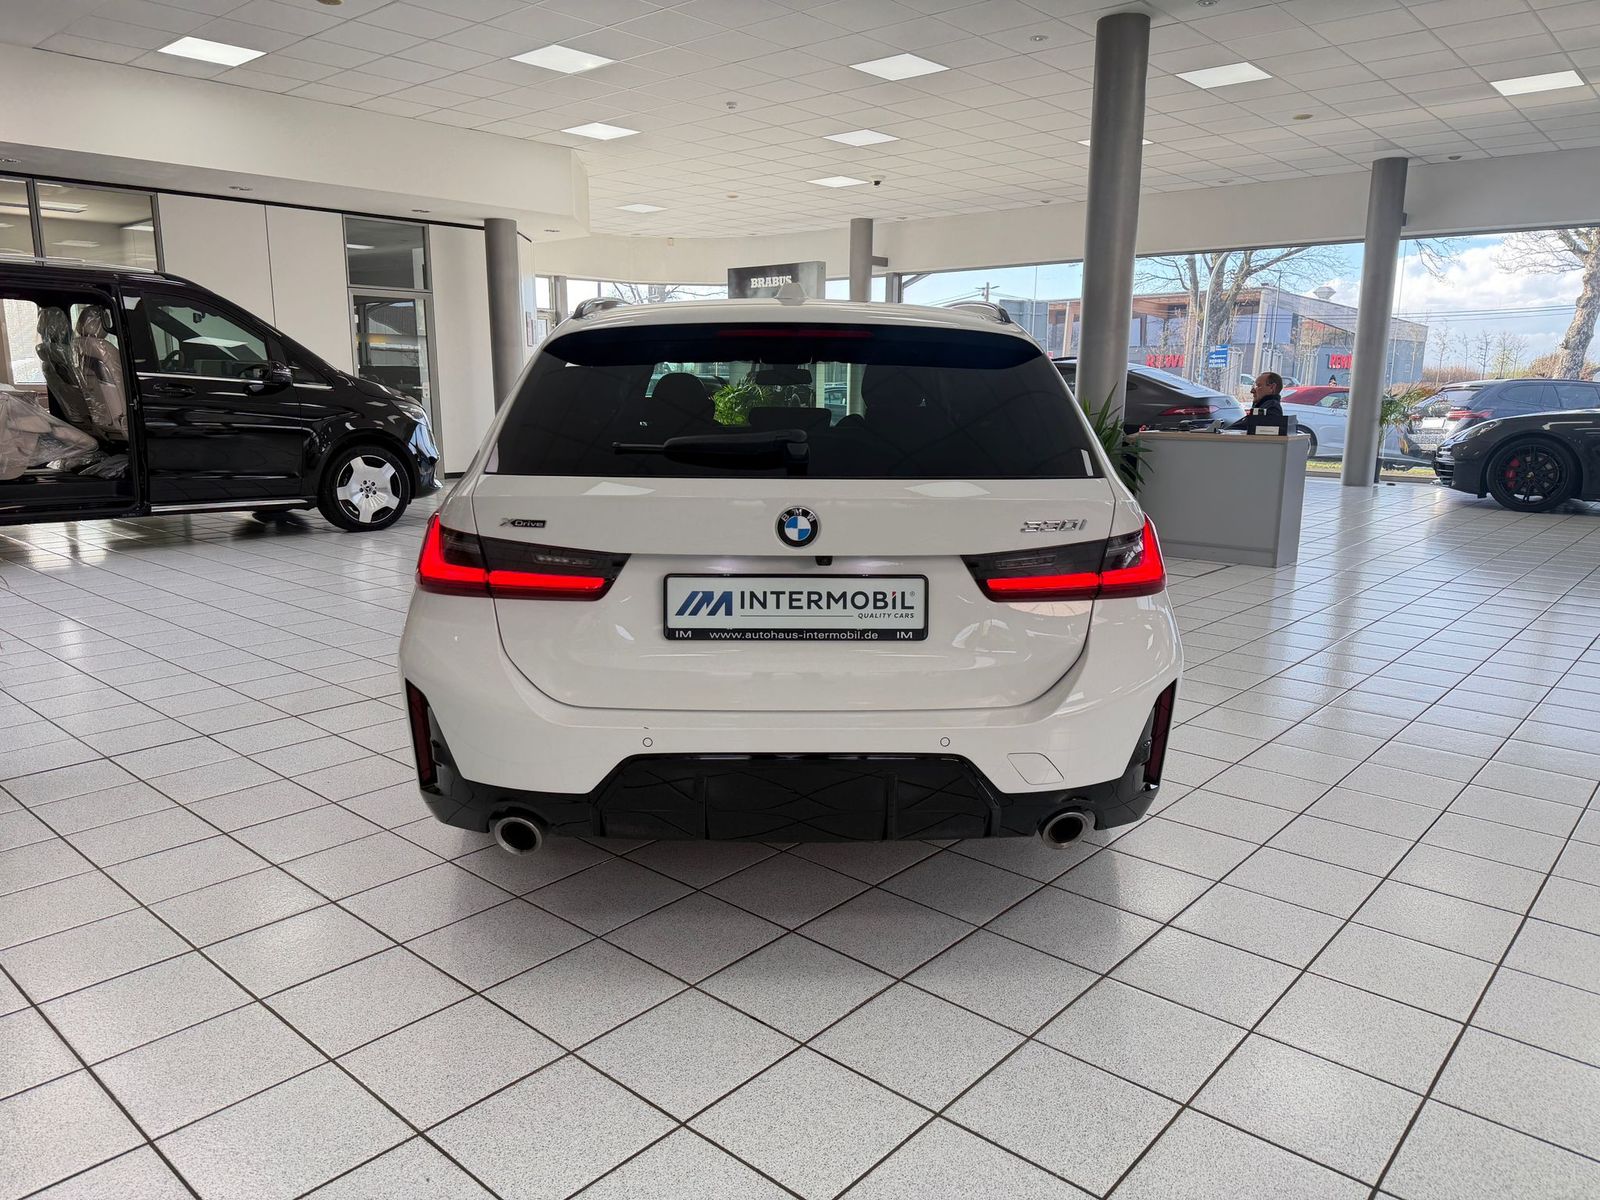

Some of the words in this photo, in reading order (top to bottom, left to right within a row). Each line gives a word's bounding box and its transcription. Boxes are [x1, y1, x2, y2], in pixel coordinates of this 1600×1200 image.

[750, 275, 792, 289] BRABUS
[780, 508, 816, 522] BMW
[675, 630, 692, 638] IM
[709, 630, 879, 640] www.autohaus-intermobil.de
[896, 631, 913, 639] IM
